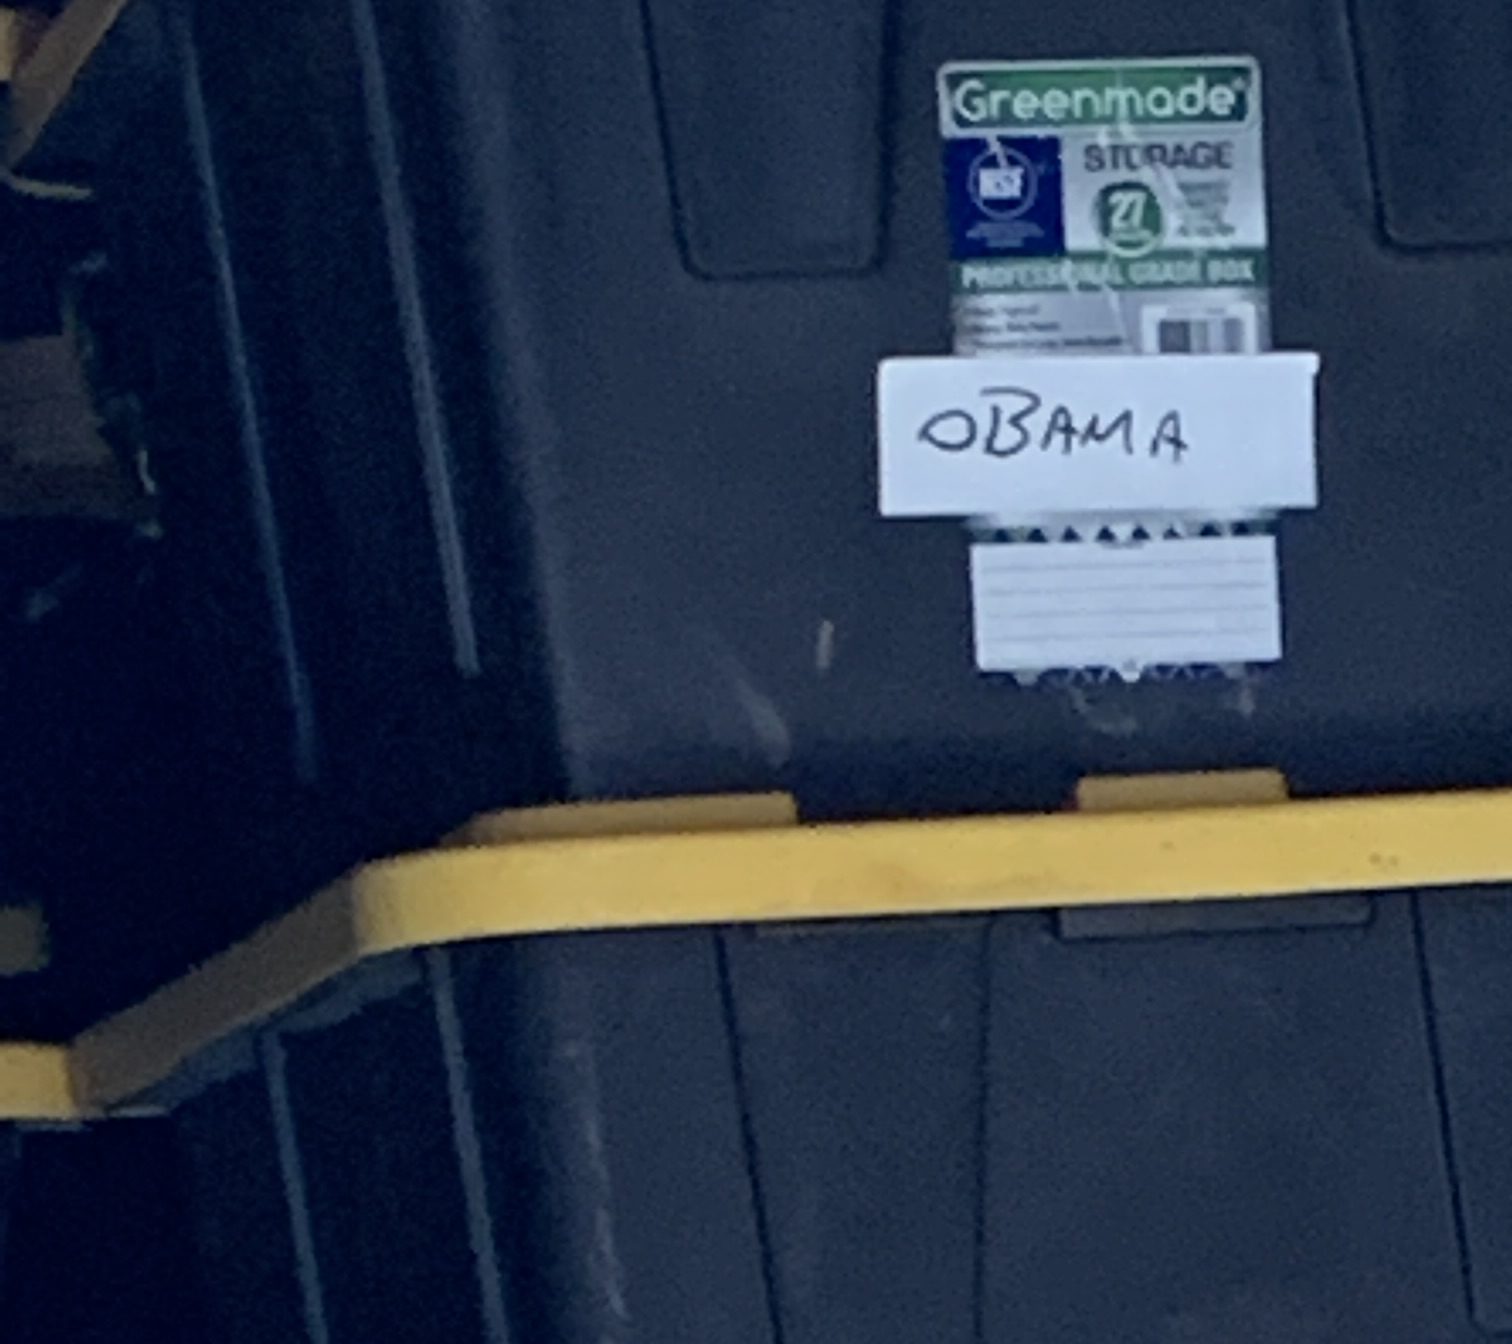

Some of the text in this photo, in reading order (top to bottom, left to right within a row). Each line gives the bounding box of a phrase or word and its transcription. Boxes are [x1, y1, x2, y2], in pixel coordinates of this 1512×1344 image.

[954, 75, 1237, 122] Greenmade
[1084, 141, 1234, 173] STORAGE
[1107, 190, 1149, 231] 27
[917, 386, 1189, 463] OBAMA
